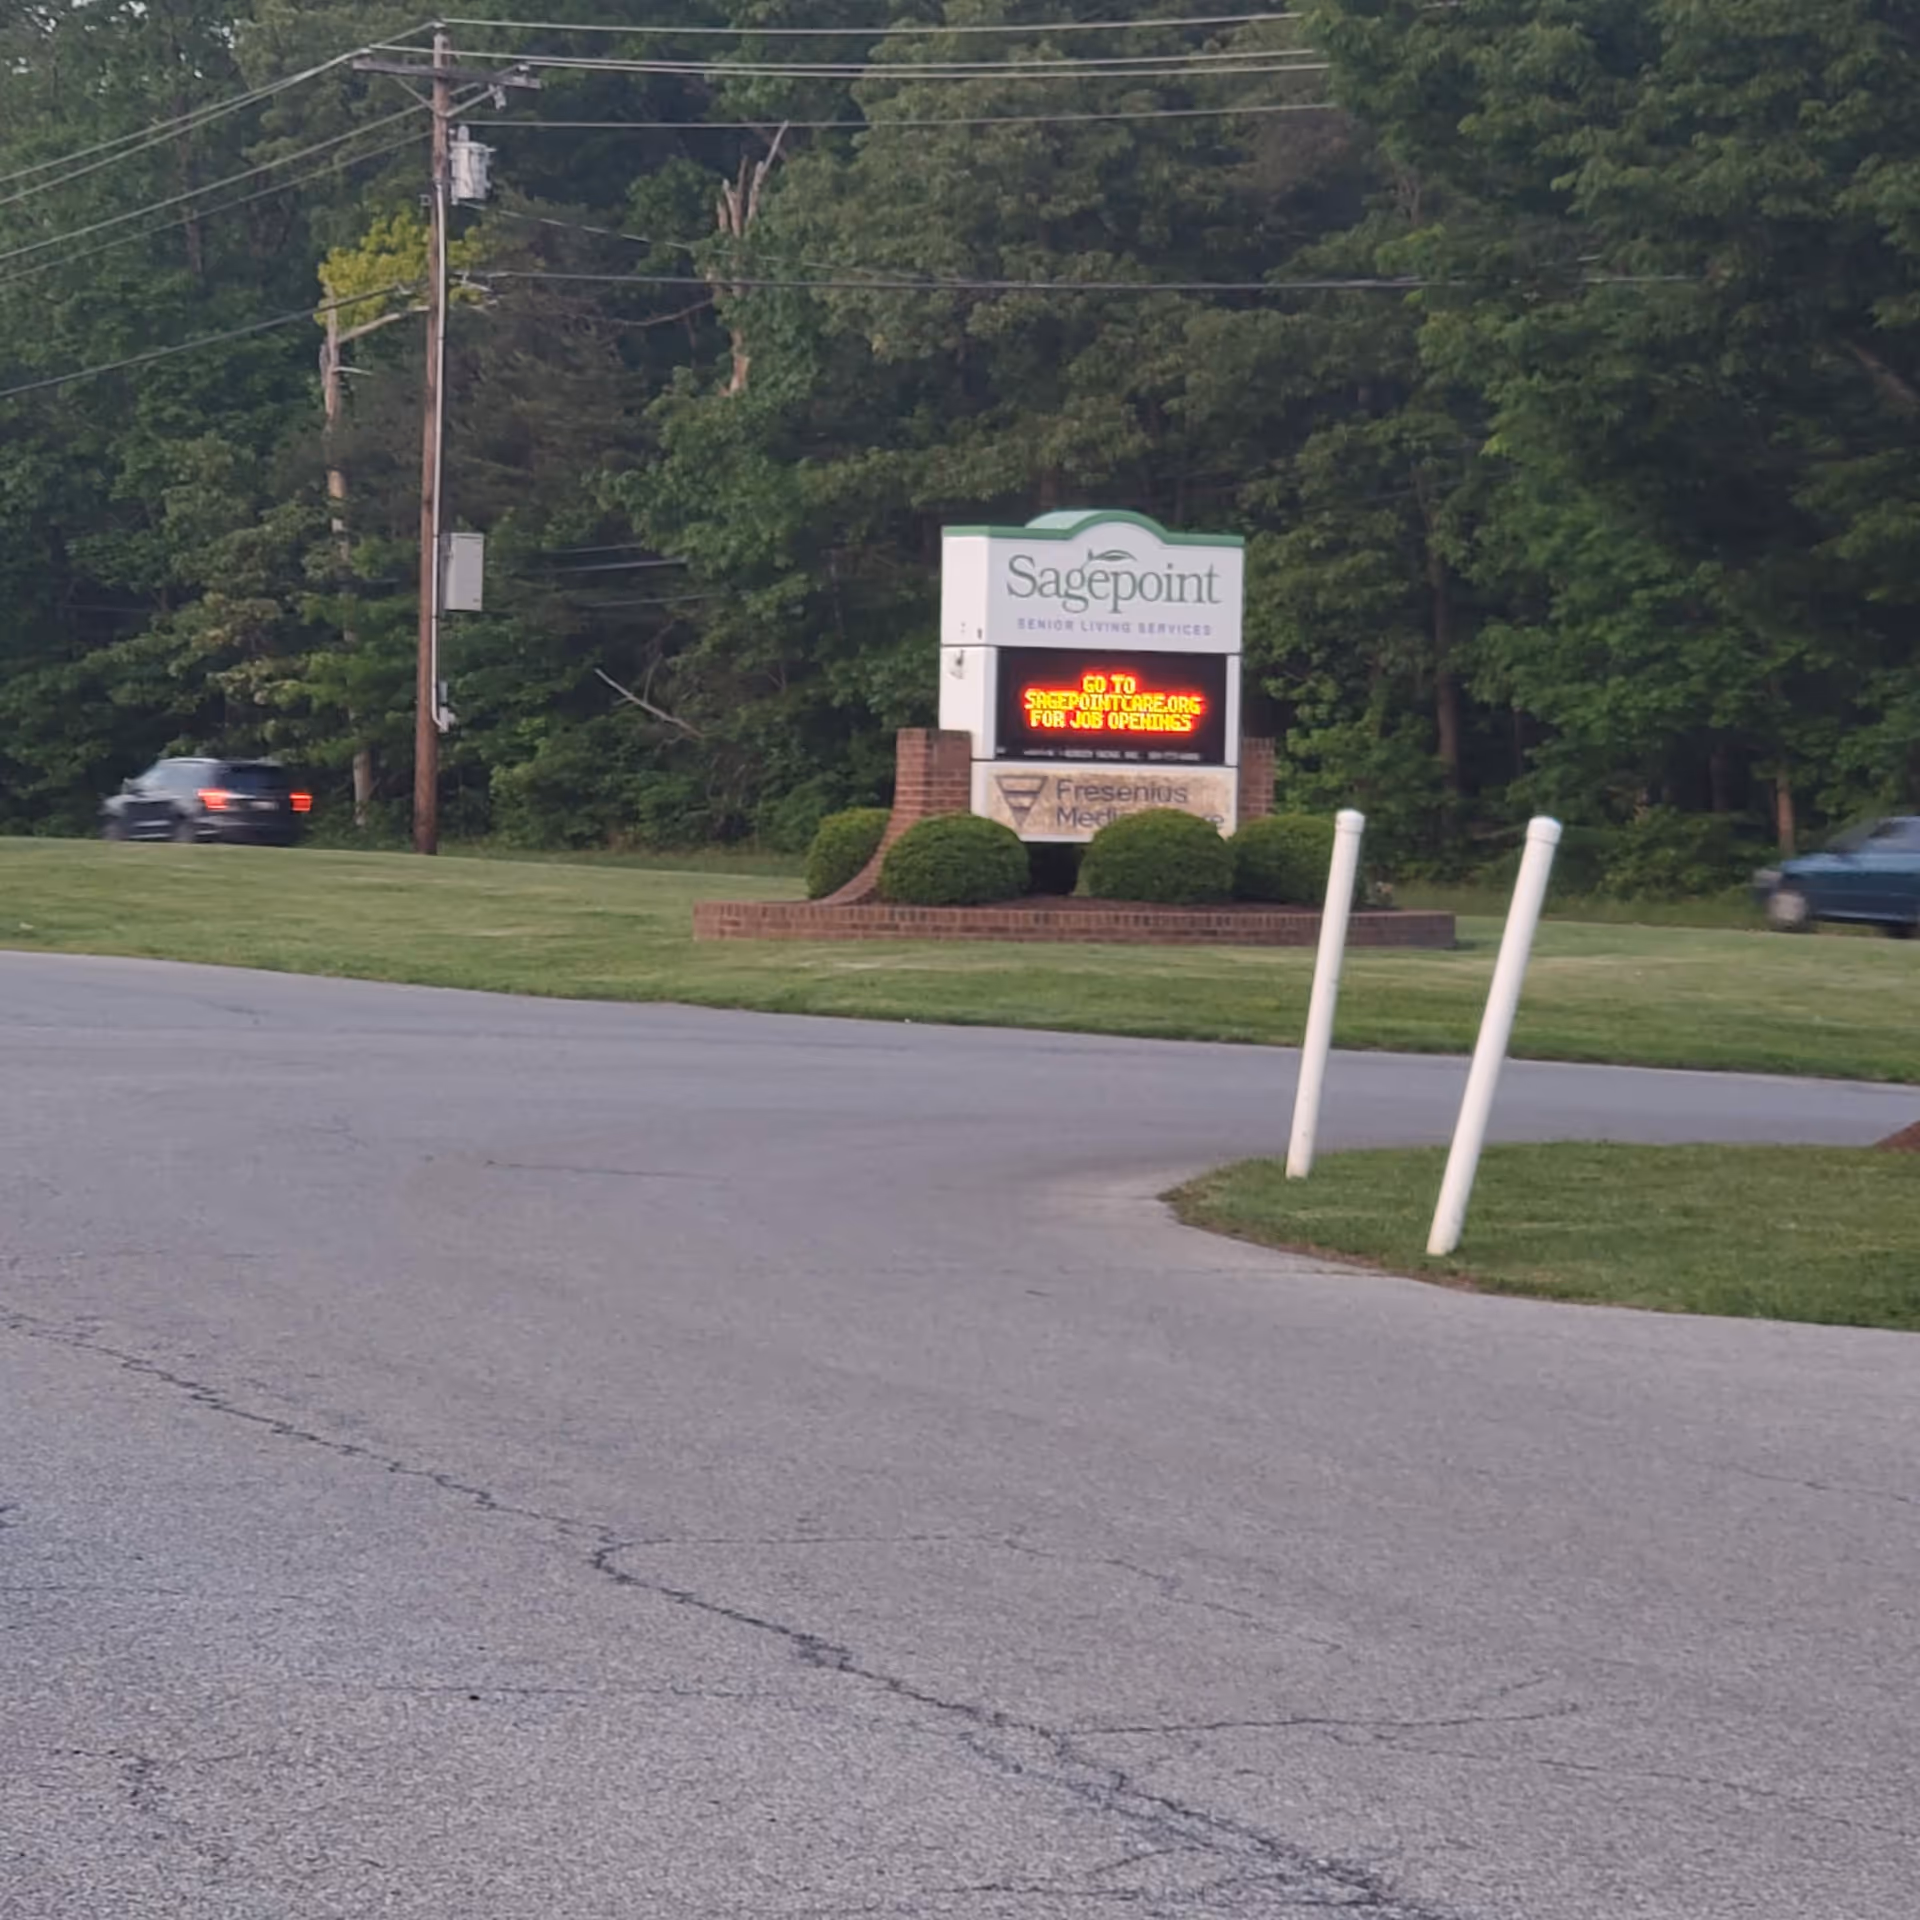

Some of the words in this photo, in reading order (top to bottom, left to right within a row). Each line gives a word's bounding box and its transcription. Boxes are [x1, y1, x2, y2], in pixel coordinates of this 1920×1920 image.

[1006, 551, 1222, 614] Sagepoint
[1017, 617, 1074, 631] SENIOR
[1080, 619, 1132, 634] LIVING
[1138, 622, 1212, 636] SERVICES
[1082, 674, 1106, 693] GO
[1110, 674, 1136, 694] TO
[1024, 688, 1202, 714] SAGEPOINTCARE.ORG
[1030, 710, 1065, 728] FOR
[1069, 711, 1103, 729] JOB
[1108, 712, 1192, 732] OPENINGS
[1056, 778, 1188, 804] Fresenius
